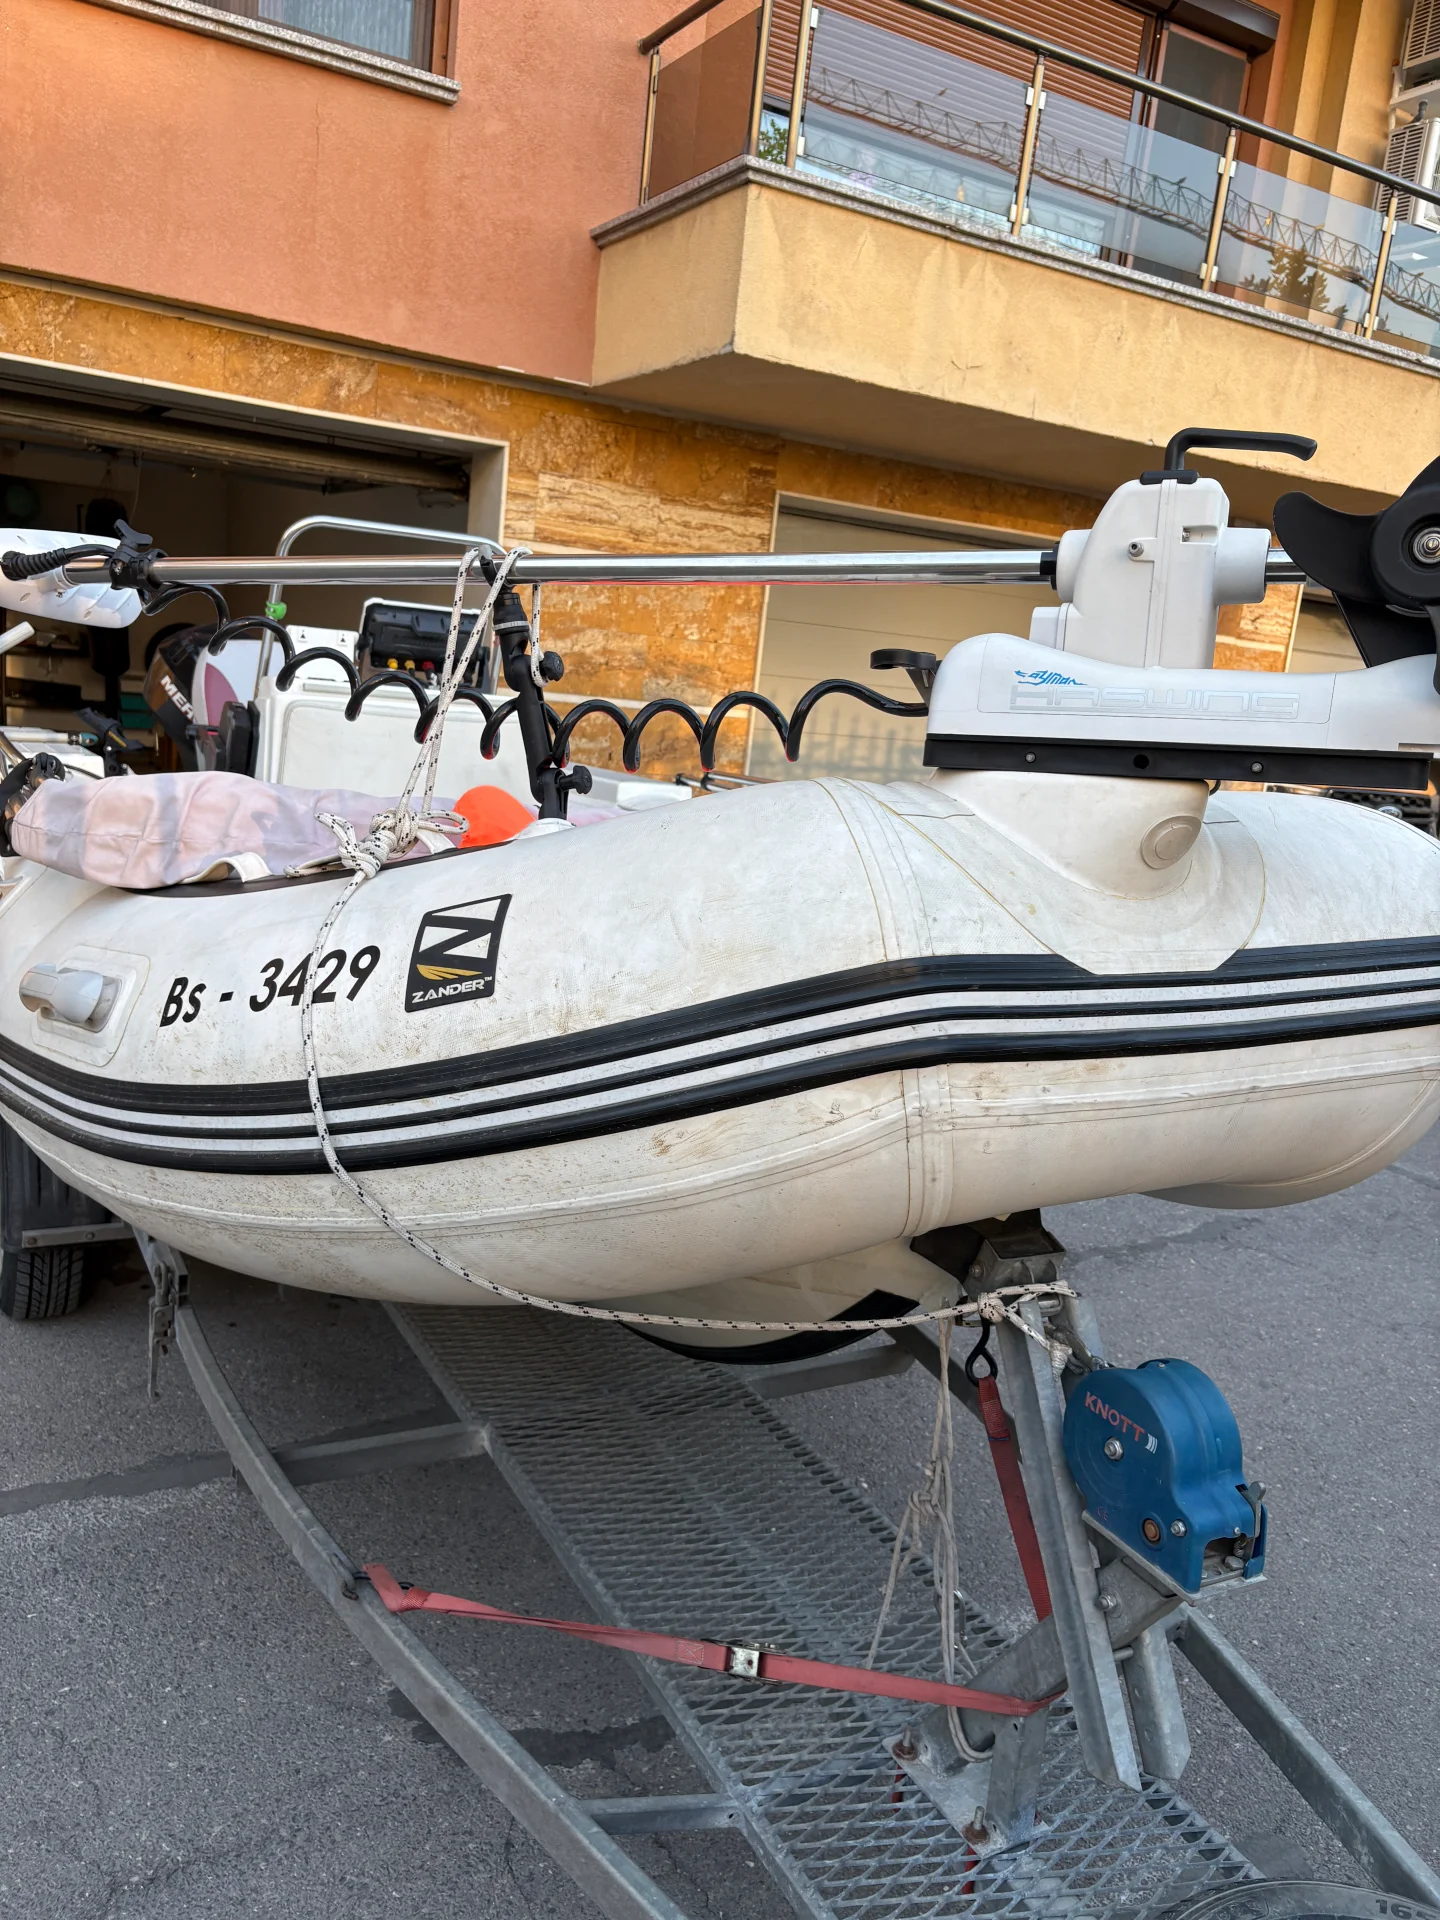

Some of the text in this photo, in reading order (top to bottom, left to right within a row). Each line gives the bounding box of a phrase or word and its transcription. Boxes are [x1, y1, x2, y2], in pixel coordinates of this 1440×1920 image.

[160, 675, 195, 721] MER
[249, 945, 381, 1012] 3429
[1085, 1391, 1145, 1441] KNOTT
